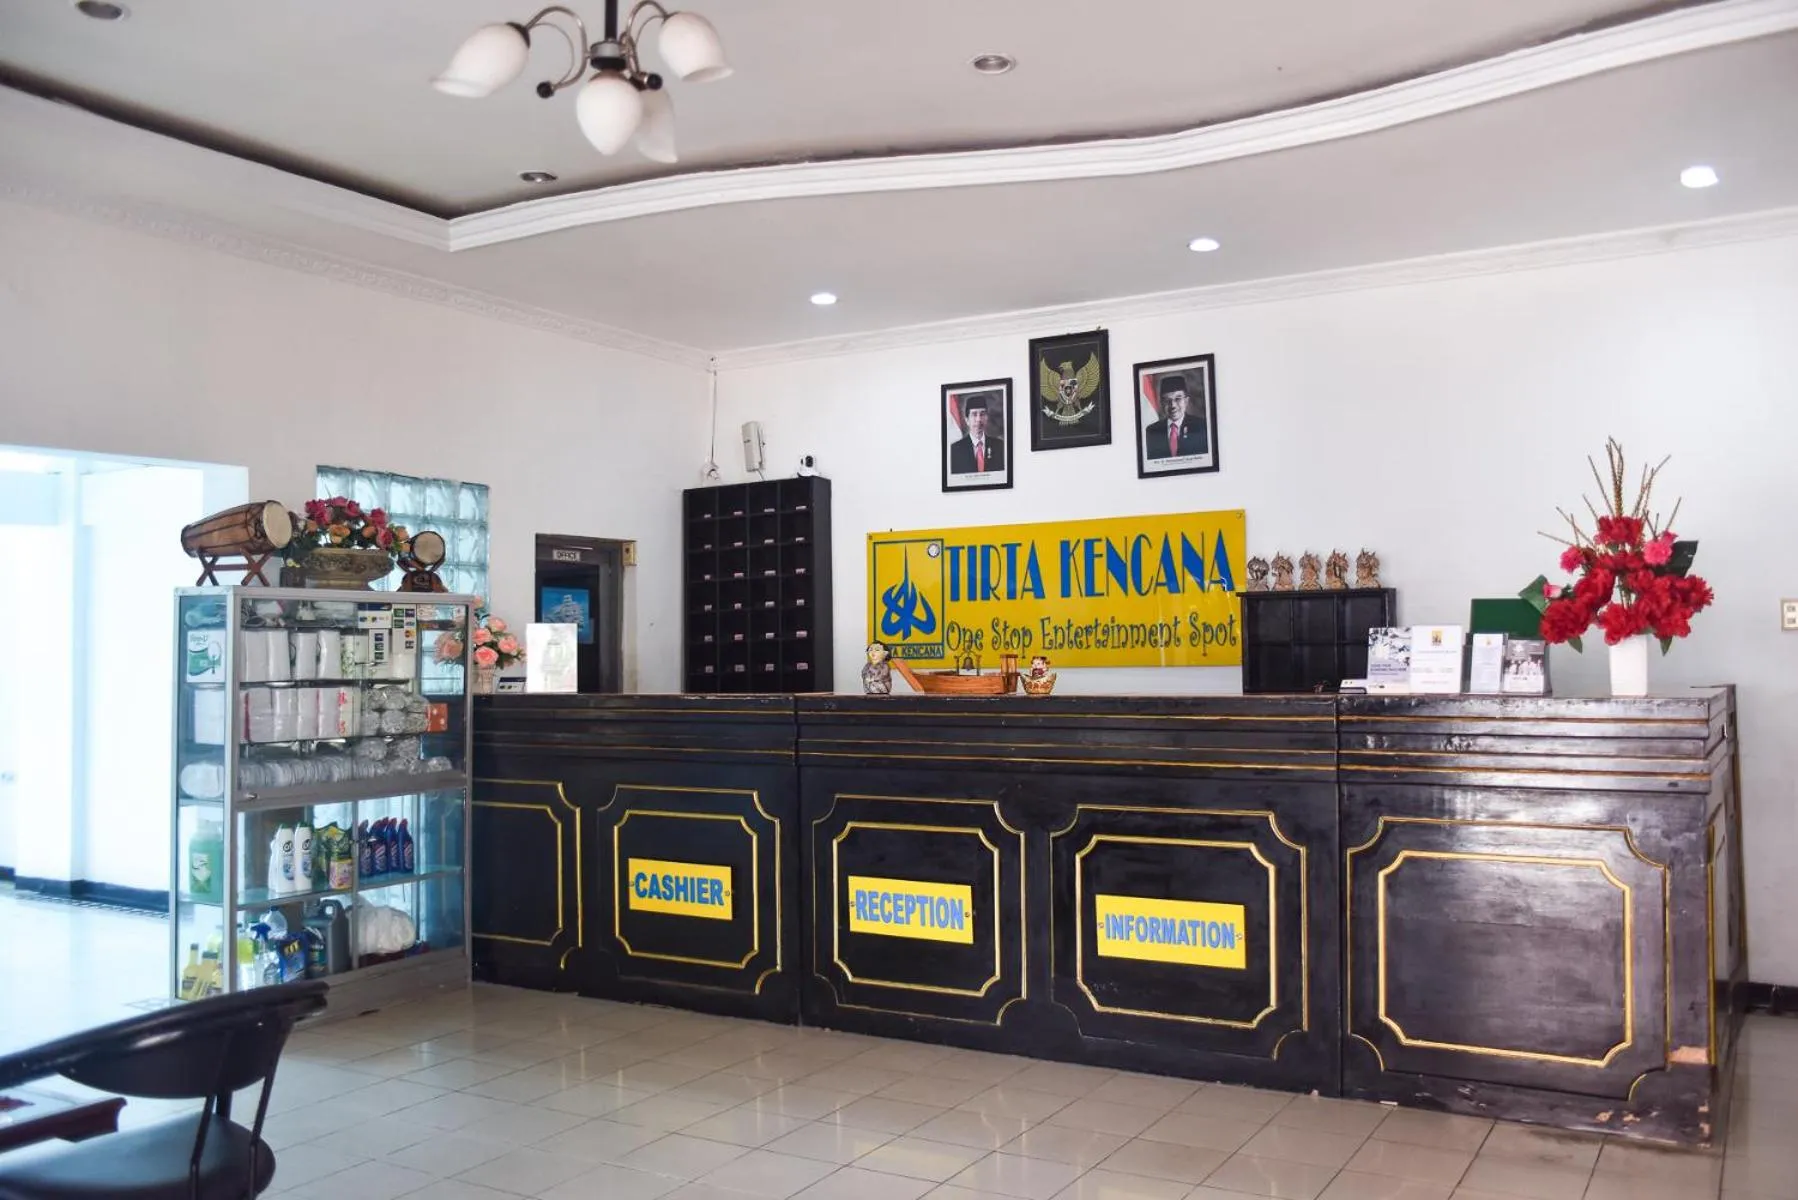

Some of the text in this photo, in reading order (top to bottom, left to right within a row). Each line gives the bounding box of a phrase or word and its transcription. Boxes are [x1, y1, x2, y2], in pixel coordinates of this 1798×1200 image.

[557, 551, 577, 561] OFFICE
[945, 528, 1235, 601] TIRTA KENCANA
[901, 645, 943, 657] KENCANA
[946, 611, 1237, 659] One Stop Entertainment Spot
[634, 872, 725, 906] CASHIER
[854, 889, 965, 931] RECEPTION
[1105, 914, 1235, 950] INFORMATION
